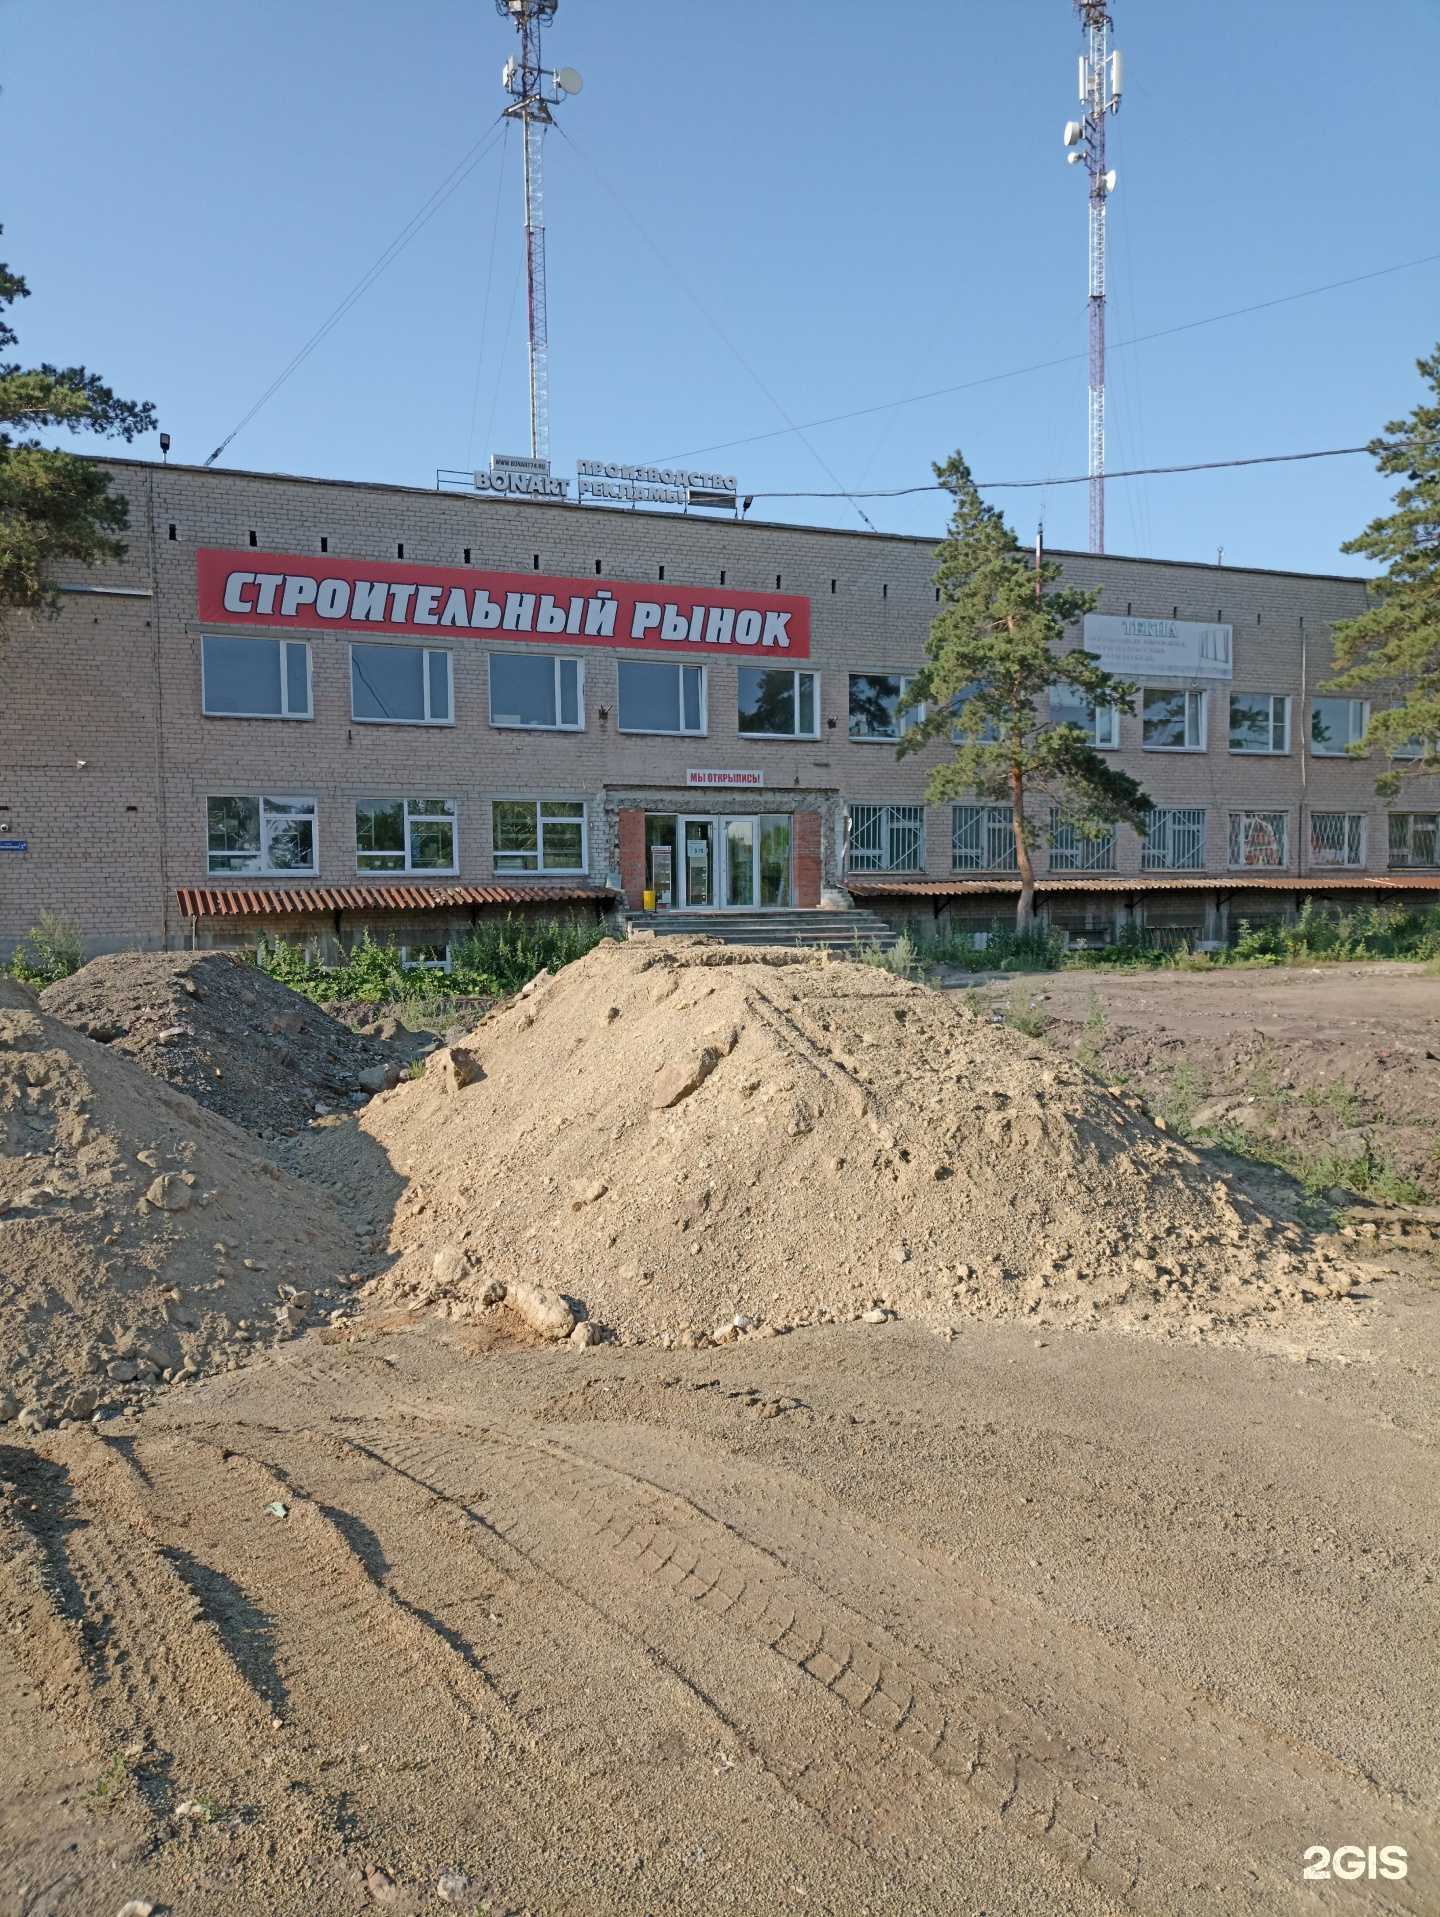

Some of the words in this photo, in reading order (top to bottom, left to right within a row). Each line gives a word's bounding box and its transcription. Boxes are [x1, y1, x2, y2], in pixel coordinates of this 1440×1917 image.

[475, 470, 569, 497] BONART
[576, 459, 737, 490] ПРОИЗВОДСТВО
[579, 479, 687, 504] РЕКЛАМЫ
[223, 571, 615, 637] СТРОИТЕЛЬНЫЙ
[630, 600, 793, 648] РЫНОК
[690, 772, 706, 783] МЫ
